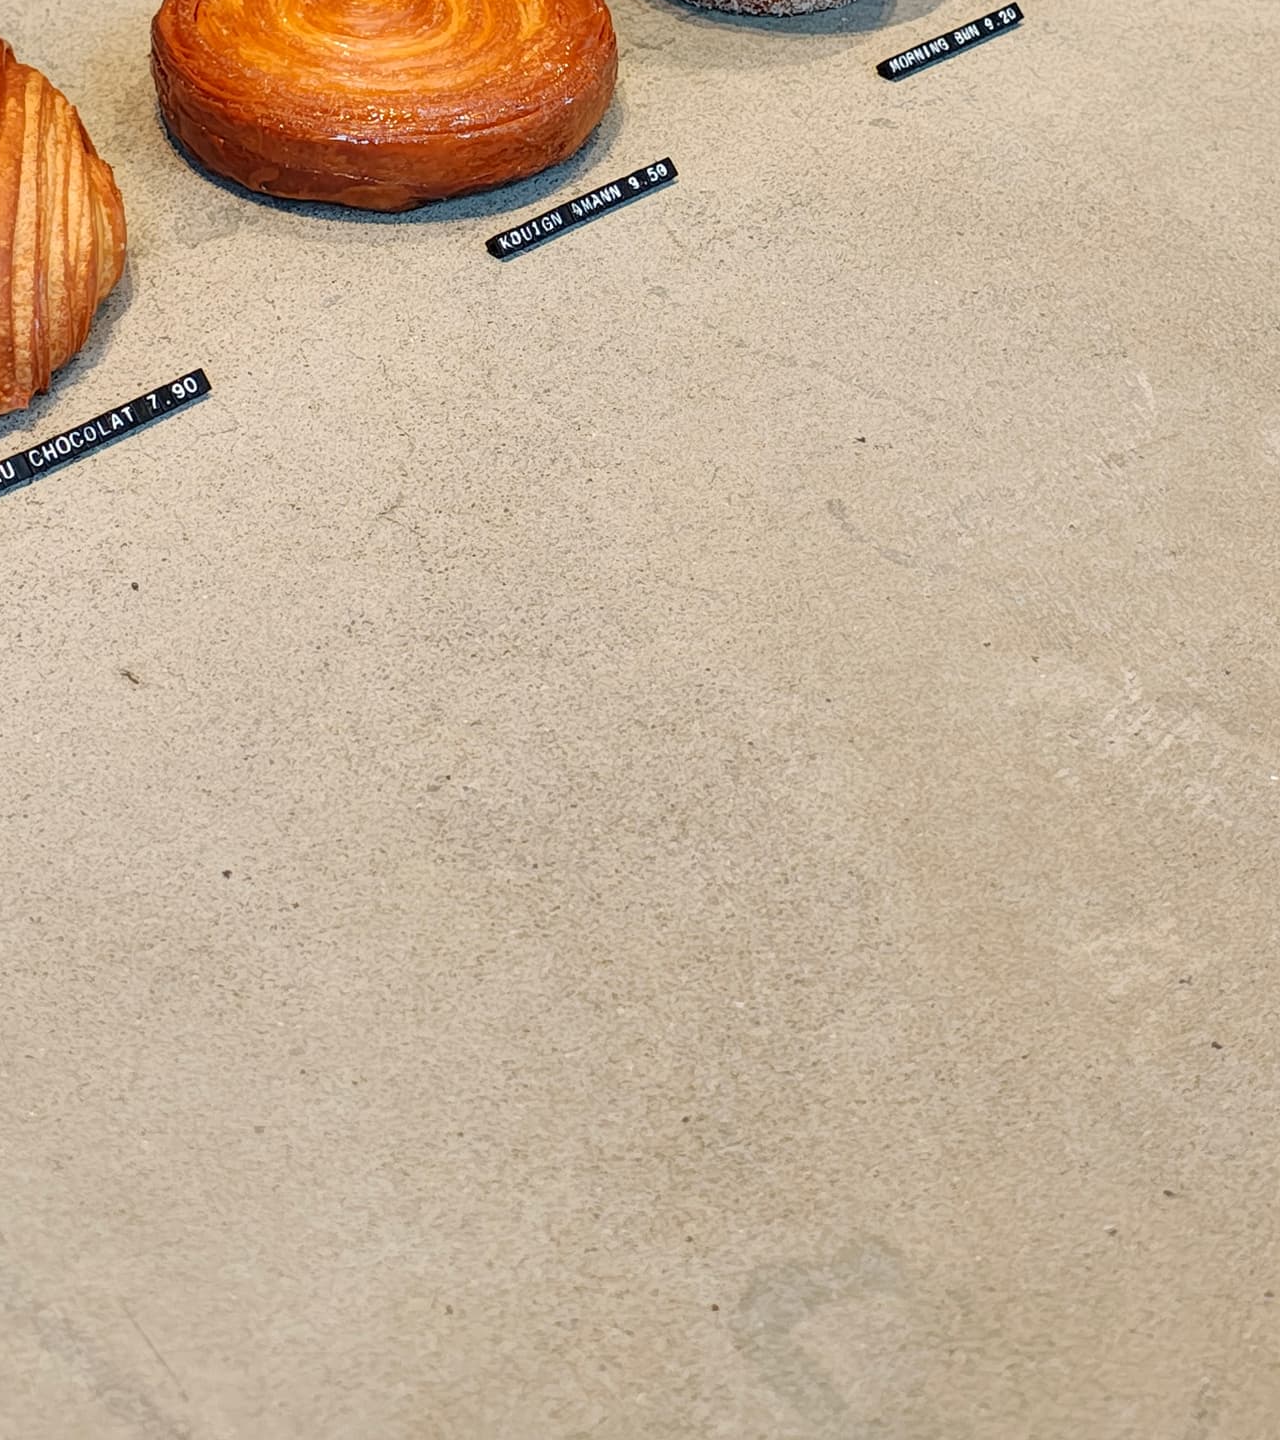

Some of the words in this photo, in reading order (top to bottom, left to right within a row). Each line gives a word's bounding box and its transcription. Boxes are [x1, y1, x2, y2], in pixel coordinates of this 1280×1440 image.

[888, 38, 950, 73] MORNING
[954, 24, 980, 45] BUN
[984, 7, 1017, 30] 9.20
[498, 212, 563, 250] KOUIGN
[628, 163, 668, 190] 9.50
[29, 406, 136, 467] CHOCOLAT
[146, 376, 198, 410] 7.90
